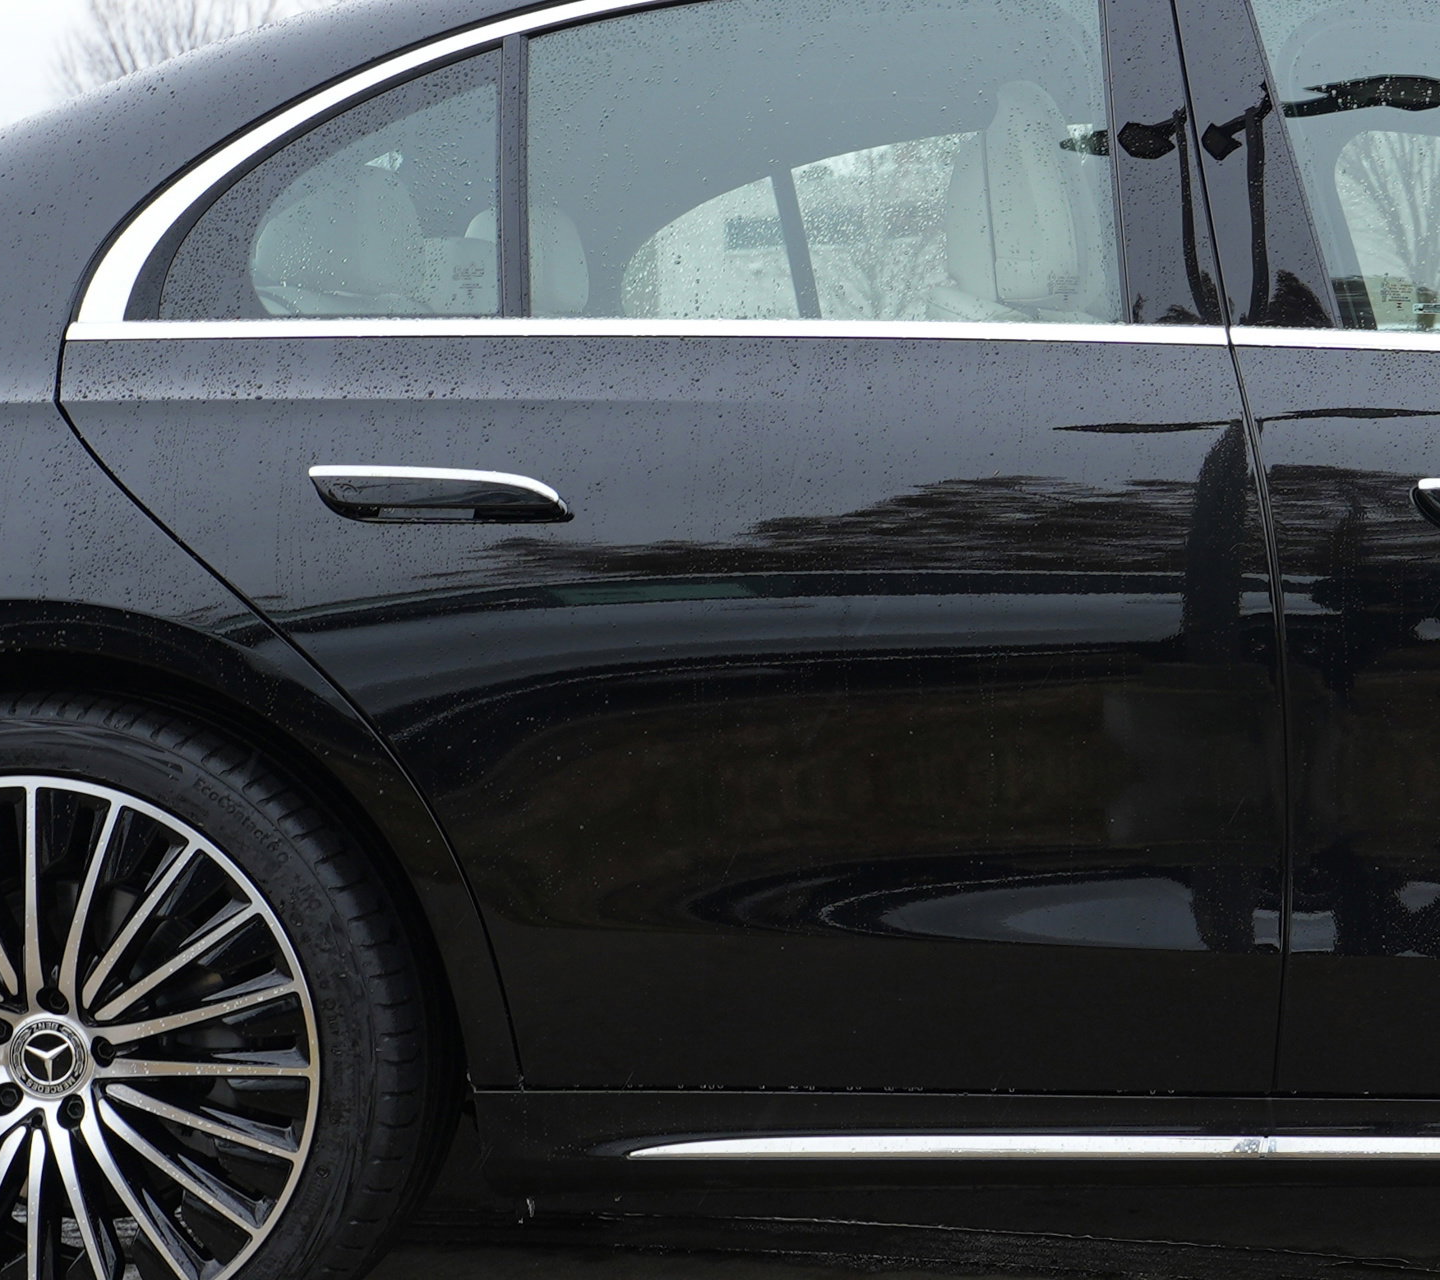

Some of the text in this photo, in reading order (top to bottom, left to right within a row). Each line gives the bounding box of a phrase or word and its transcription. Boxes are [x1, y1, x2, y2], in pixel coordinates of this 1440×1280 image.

[192, 777, 270, 843] EcoContact
[31, 1022, 59, 1033] BENZ
[25, 1075, 76, 1094] MERCEDES
